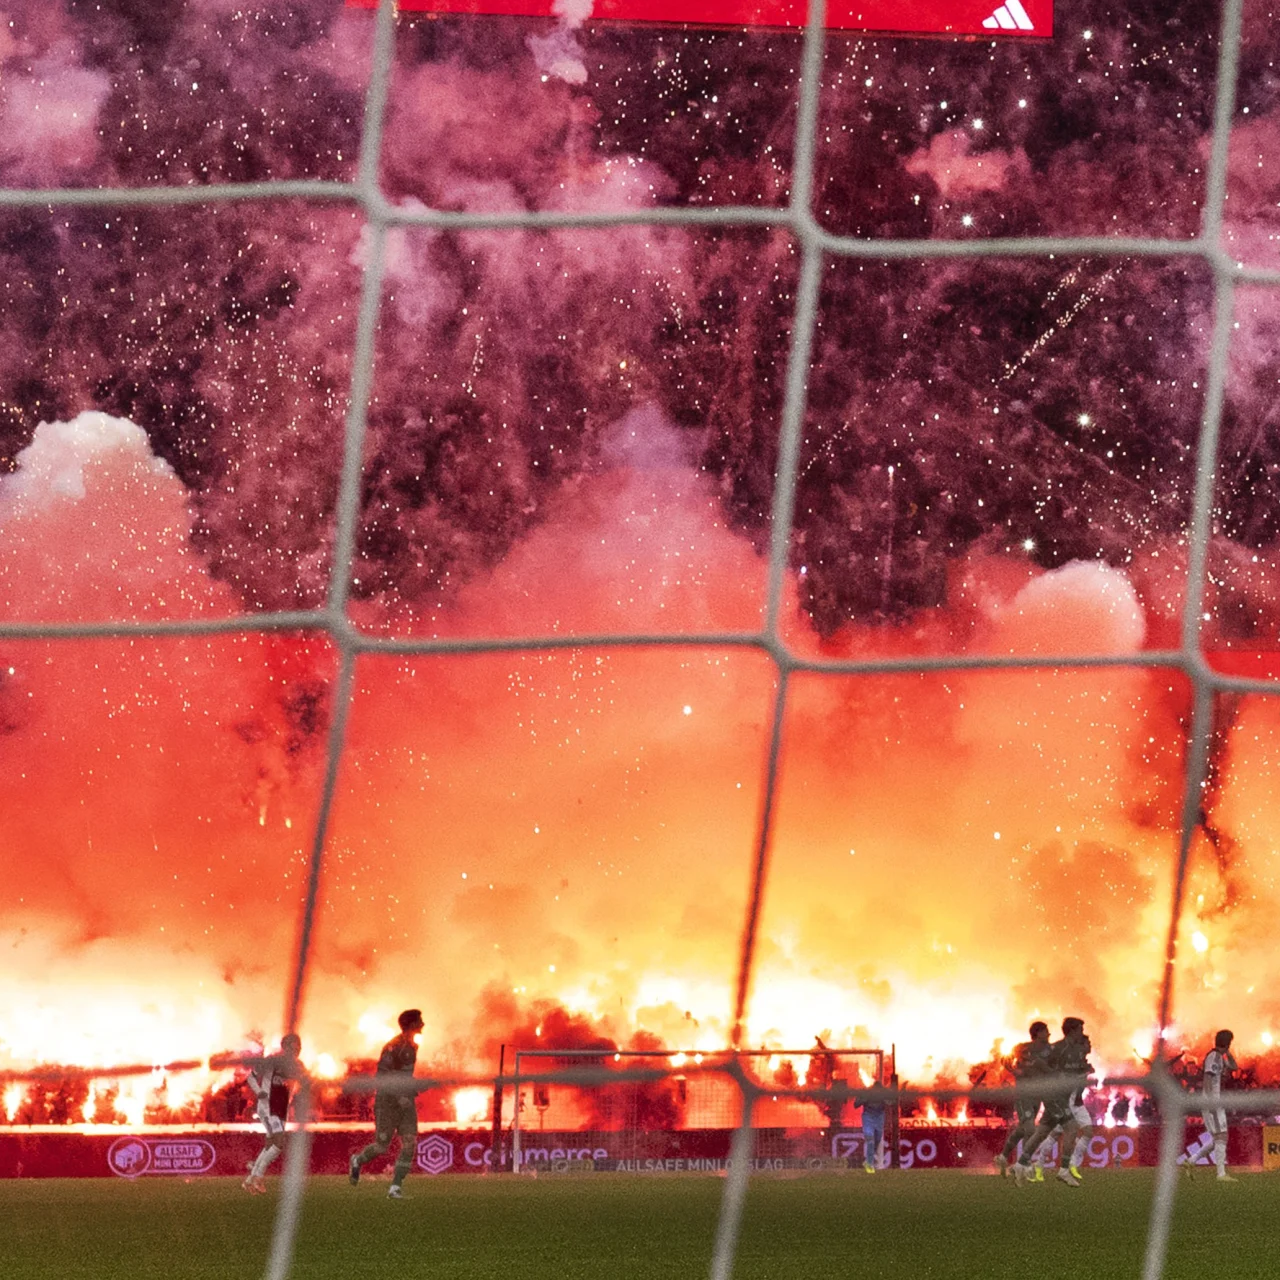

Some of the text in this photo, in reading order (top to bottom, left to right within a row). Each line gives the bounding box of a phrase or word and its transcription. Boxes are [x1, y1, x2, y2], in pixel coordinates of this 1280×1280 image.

[616, 1158, 783, 1171] ALLSAFE MINI OSLAG
